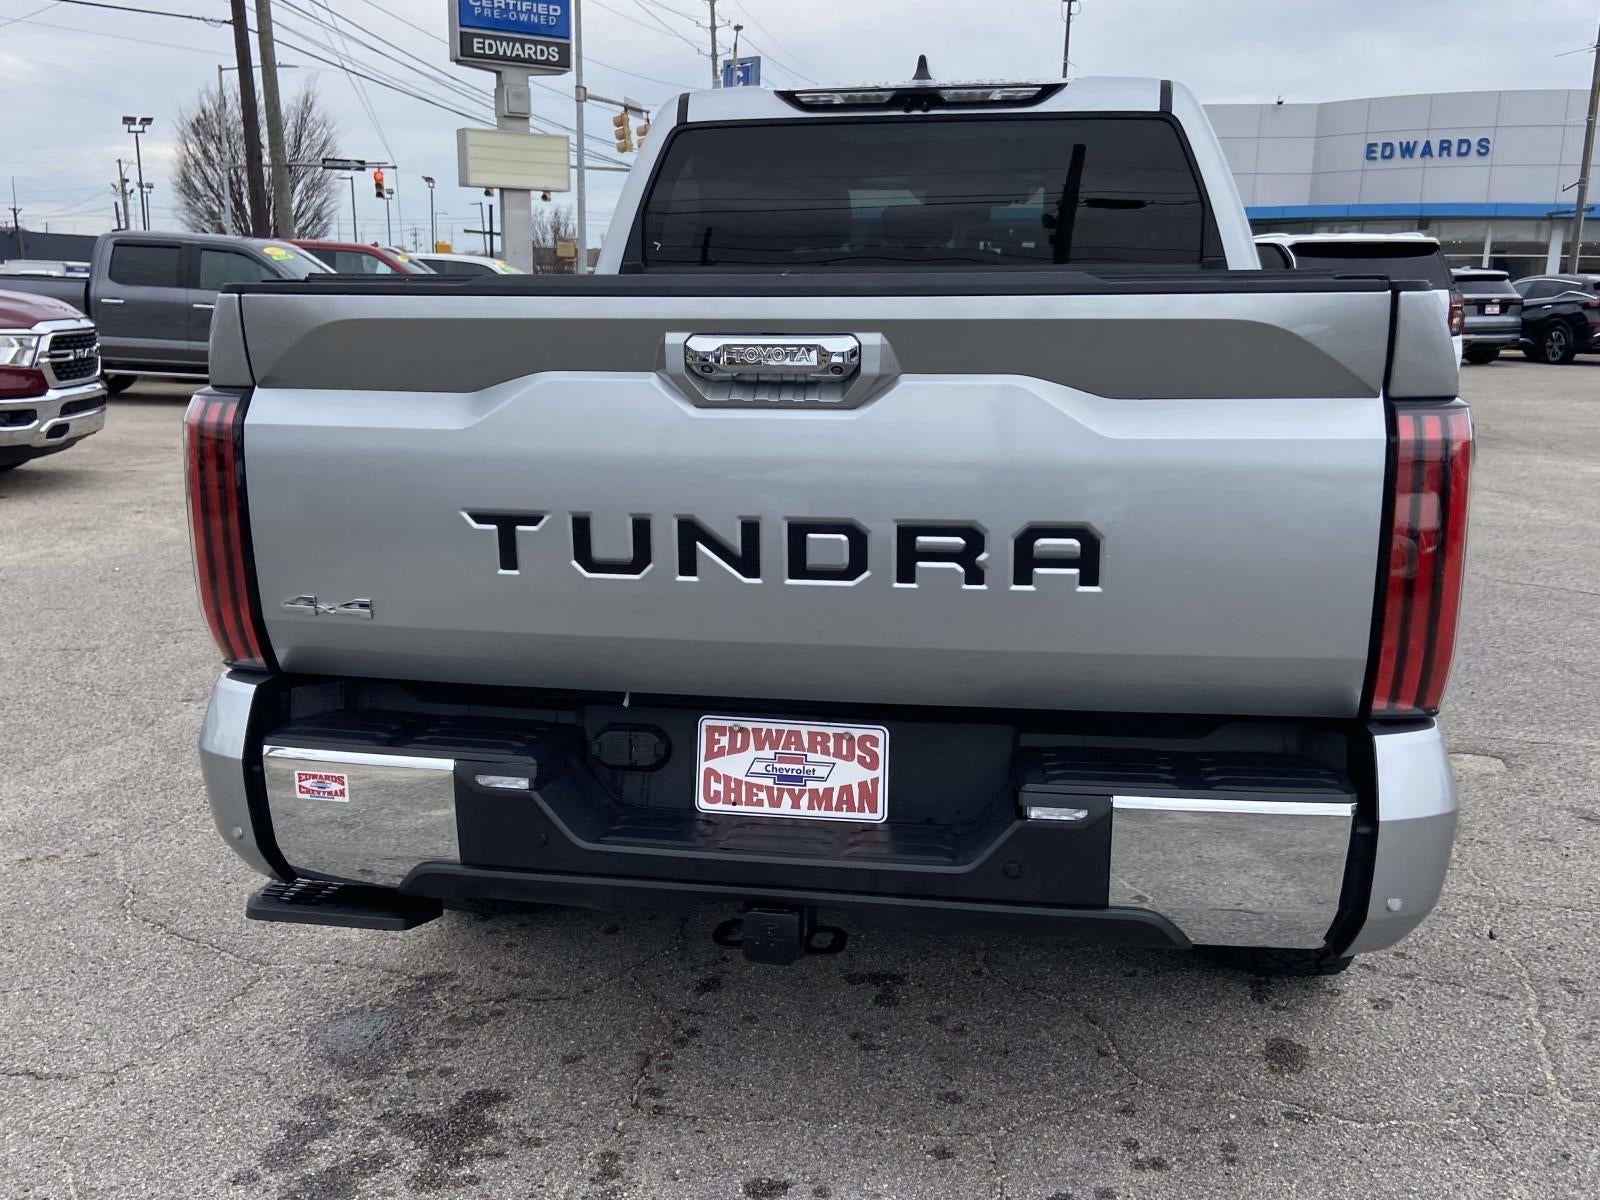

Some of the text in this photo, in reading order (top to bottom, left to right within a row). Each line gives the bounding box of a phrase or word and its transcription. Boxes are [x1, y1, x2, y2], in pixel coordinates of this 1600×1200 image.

[474, 7, 557, 25] PRE-OWNED
[473, 38, 560, 62] EDWARDS
[1365, 138, 1491, 161] EDWARDS
[731, 347, 811, 363] TOYOTA
[459, 507, 1105, 593] TUNDRA
[704, 725, 880, 772] EDWARDS
[297, 773, 345, 786] EDWARDS
[764, 764, 816, 776] Chevrolet
[298, 783, 346, 798] CHEVYMAN
[702, 766, 880, 815] CHEVYMAN
